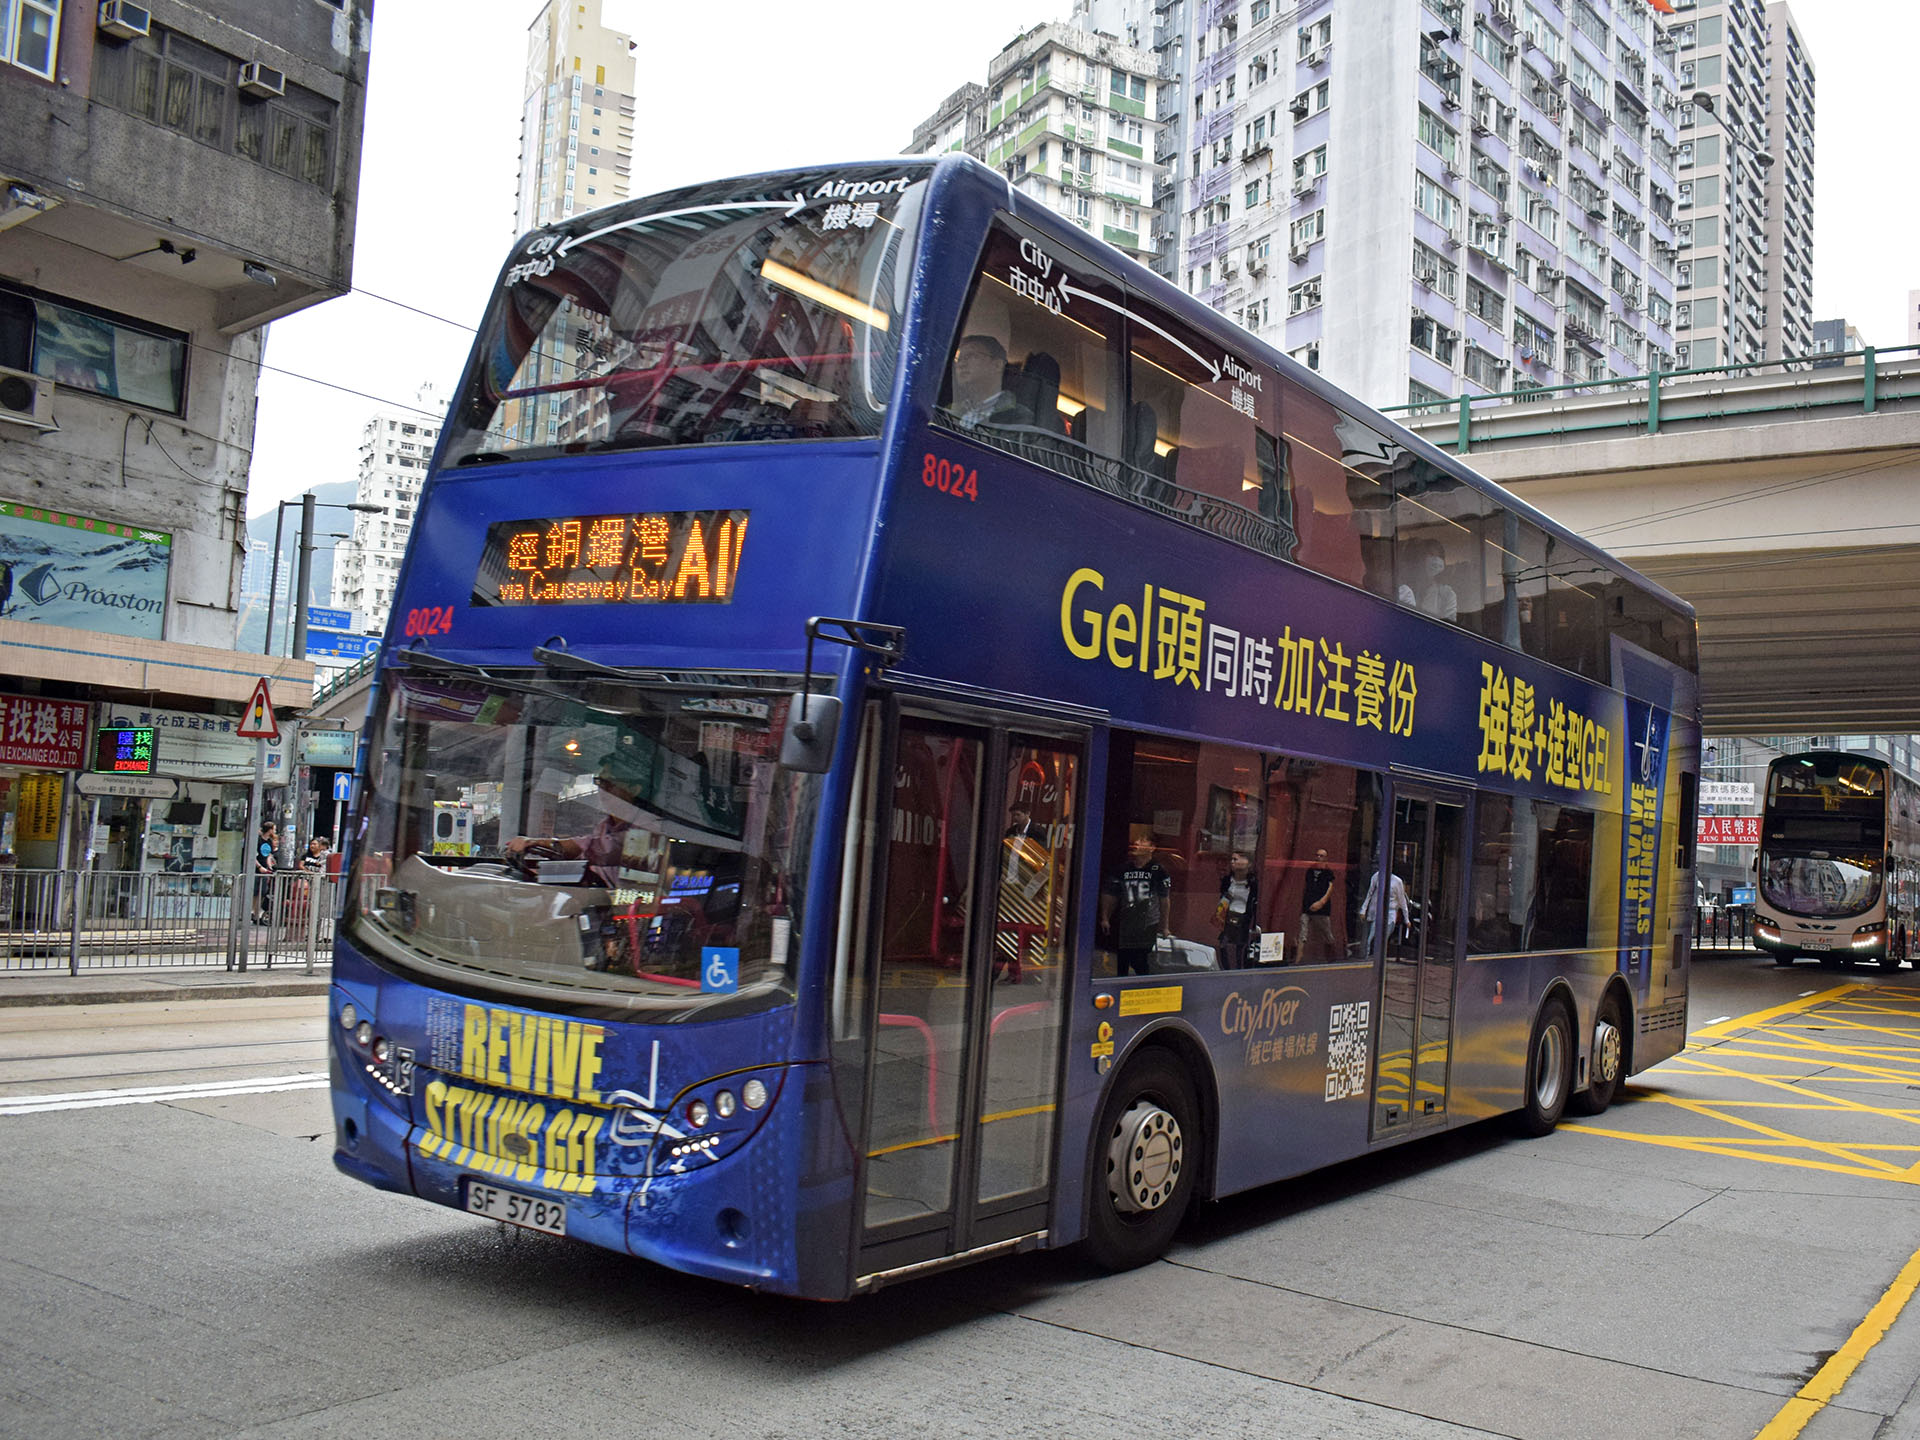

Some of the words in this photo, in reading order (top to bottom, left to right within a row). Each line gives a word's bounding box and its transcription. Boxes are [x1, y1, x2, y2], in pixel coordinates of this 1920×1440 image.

[814, 176, 910, 201] Airport
[822, 202, 878, 231] 機場
[526, 234, 562, 256] City
[1019, 238, 1054, 278] City
[504, 254, 556, 286] 市中心
[1009, 266, 1062, 315] 市中心
[1223, 354, 1263, 393] Airport
[1231, 385, 1256, 419] 機場
[922, 453, 979, 502] 8024
[508, 516, 670, 571] 經銅鑼灣
[63, 581, 163, 614] Proaston
[500, 575, 525, 601] via
[528, 570, 628, 601] Causeway
[630, 567, 675, 602] Bay
[406, 605, 454, 637] 8024
[7, 746, 49, 762] EXCHANGE
[114, 760, 149, 771] EXCHANGE
[103, 776, 135, 785] Hennessy
[1642, 786, 1658, 829] GEL
[1624, 782, 1645, 901] REVIVE
[1637, 831, 1656, 936] STYLING
[462, 1003, 606, 1103] REVIVE
[543, 1105, 605, 1197] GEL
[472, 1186, 496, 1209] SF
[505, 1195, 563, 1231] 5782
